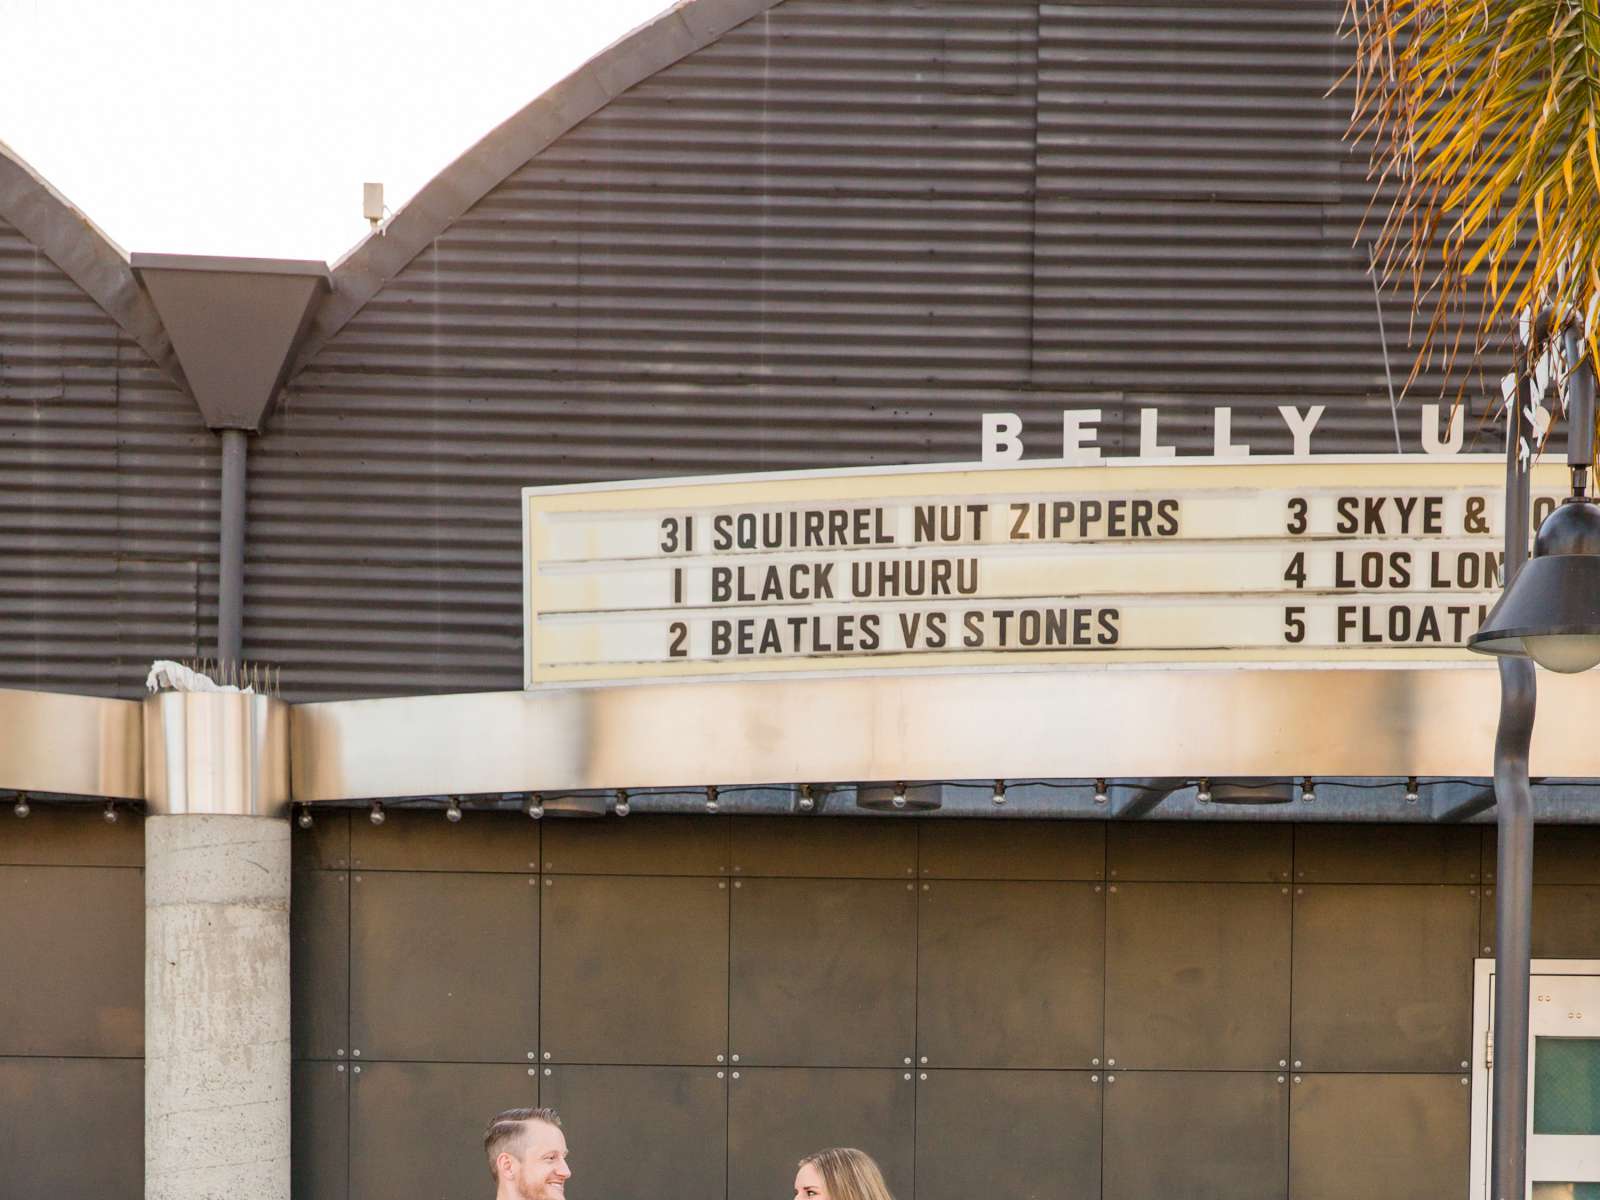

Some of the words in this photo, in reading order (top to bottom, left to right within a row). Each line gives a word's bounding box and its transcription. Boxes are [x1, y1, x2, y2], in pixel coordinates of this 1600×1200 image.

[981, 404, 1326, 463] BELLY
[661, 516, 693, 552] 31
[714, 508, 894, 550] SQUIRREL
[914, 505, 988, 542] NUT
[1010, 500, 1179, 539] ZIPPERS
[1287, 497, 1308, 535] 3
[1337, 496, 1443, 534] SKYE
[1464, 496, 1490, 534] &
[712, 563, 834, 602] BLACK
[852, 558, 978, 597] UHURU
[1284, 552, 1307, 588] 4
[1335, 552, 1412, 588] LOS
[1431, 551, 1532, 588] LON
[669, 622, 688, 657] 2
[711, 614, 880, 655] BEATLES
[899, 612, 946, 648] VS
[963, 608, 1119, 647] STONES
[1284, 606, 1305, 643] 5
